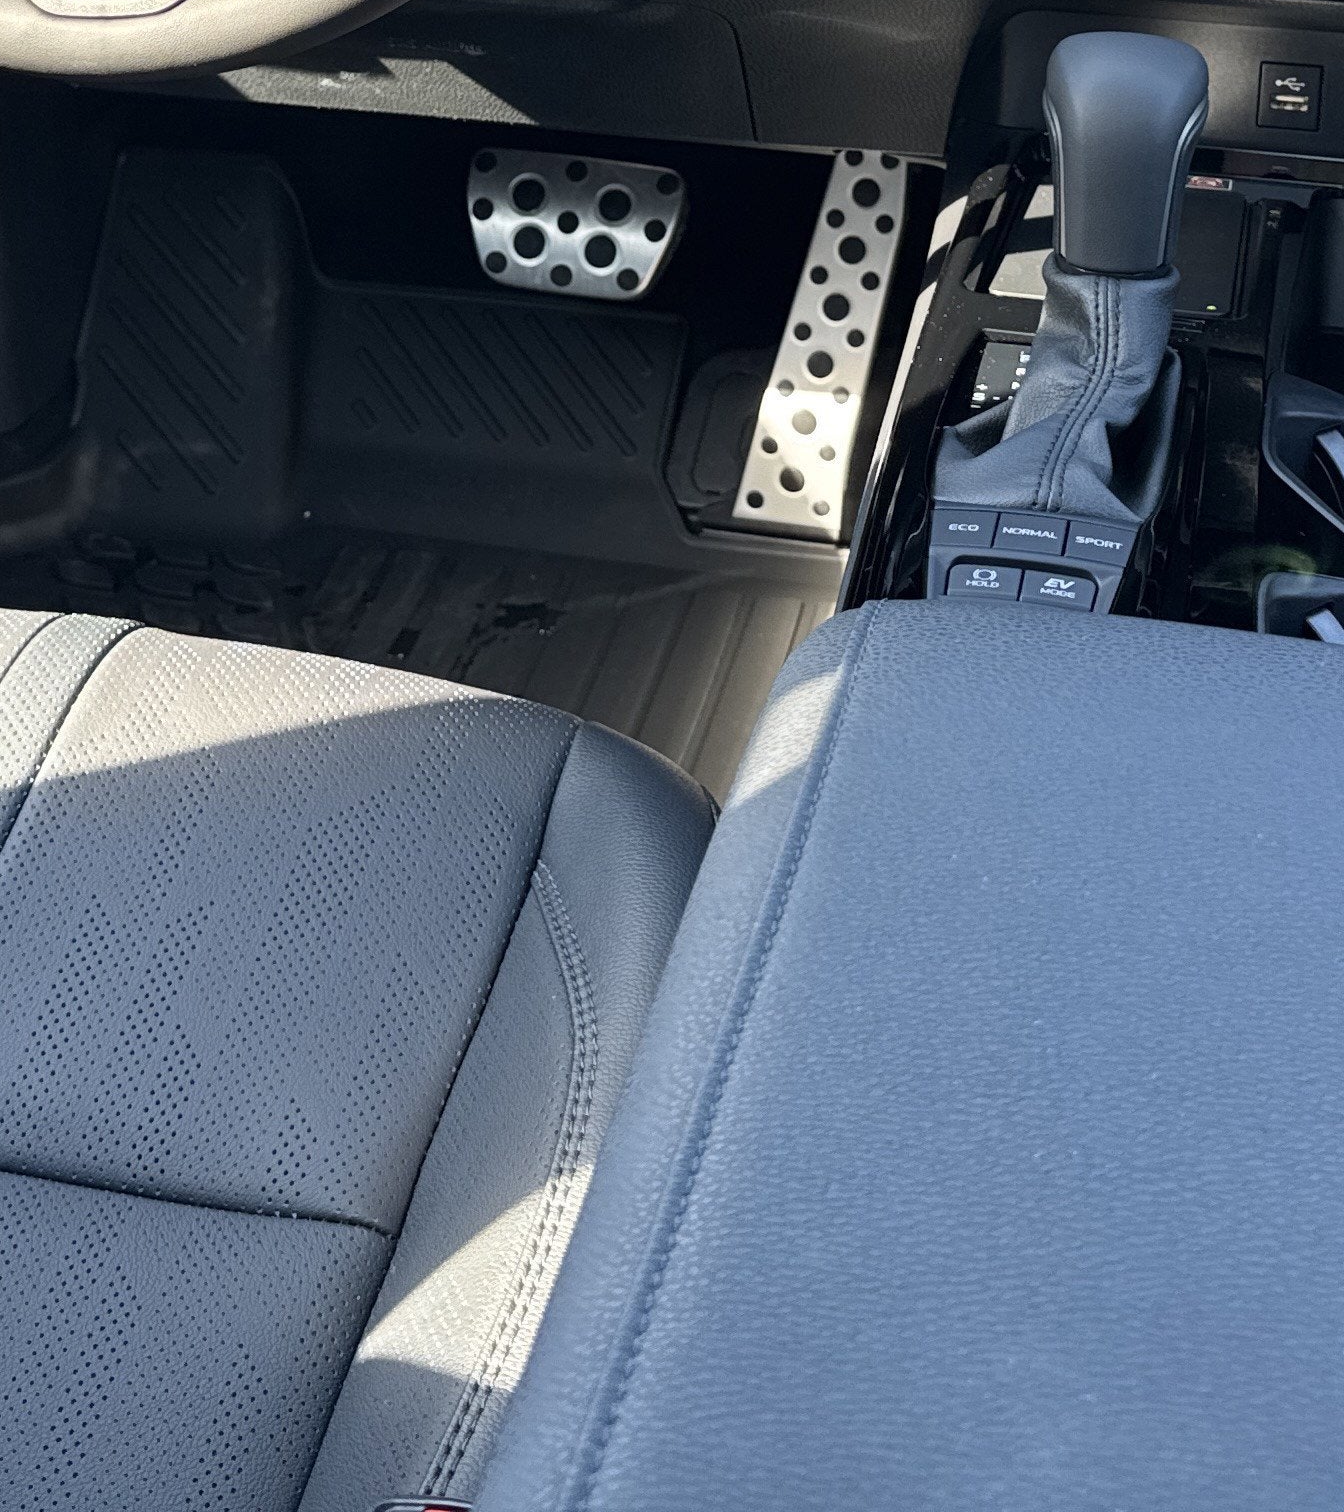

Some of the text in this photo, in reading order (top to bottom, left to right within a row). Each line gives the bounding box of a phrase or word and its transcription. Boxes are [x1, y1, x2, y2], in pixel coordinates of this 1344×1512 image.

[948, 523, 979, 532] ECO
[1002, 525, 1058, 540] NORMAL
[1074, 535, 1124, 551] SPORT
[965, 579, 1000, 589] HOLD
[1043, 578, 1075, 589] EV
[1039, 587, 1076, 599] MODE
